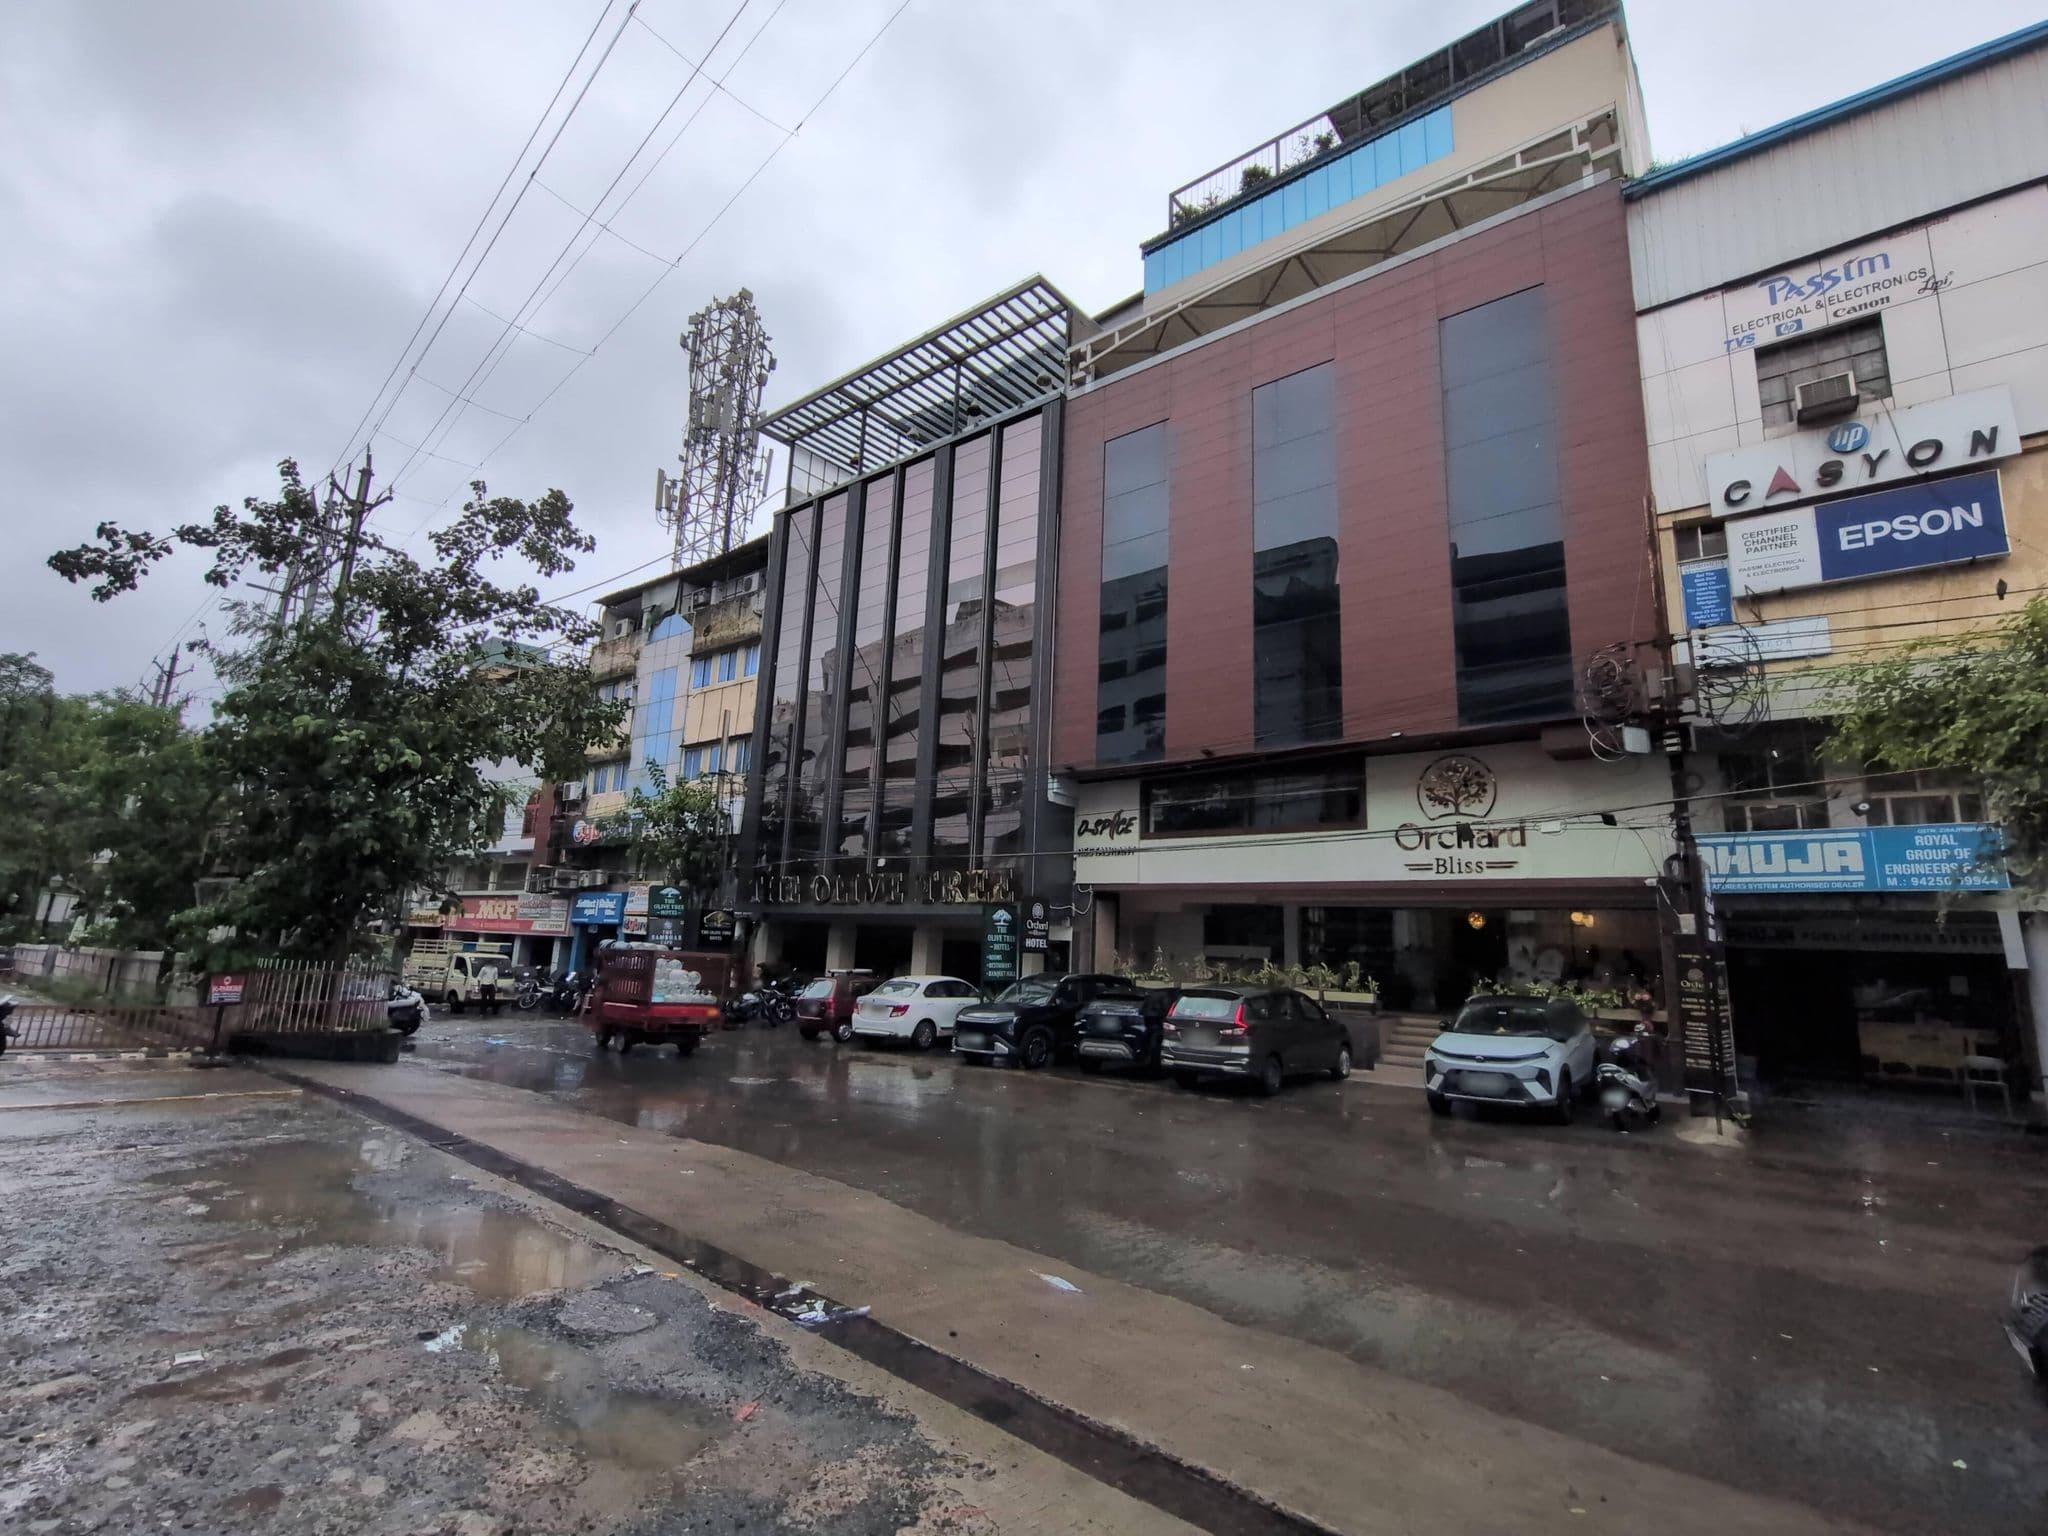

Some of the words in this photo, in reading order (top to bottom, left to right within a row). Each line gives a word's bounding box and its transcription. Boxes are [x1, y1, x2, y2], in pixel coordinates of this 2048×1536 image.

[1732, 305, 1811, 335] ELECTRICAL
[1815, 299, 1824, 309] &
[1827, 267, 1927, 306] ELECTRONICS
[1832, 296, 1891, 318] Canon
[1724, 333, 1755, 352] TVS
[1741, 524, 1799, 540] CERTIFIED
[1838, 502, 1984, 551] EPSON
[1744, 533, 1797, 547] CHANNEL
[1746, 540, 1798, 554] PARTNER
[1764, 558, 1805, 569] ELECTRICAL
[1914, 834, 1959, 846] ROYAL
[1905, 848, 1951, 861] GROUP
[1434, 857, 1484, 874] Bliss
[1884, 863, 1959, 875] ENGINEERS
[811, 873, 904, 903] OLIVE
[1831, 881, 1864, 889] DEALER
[476, 900, 517, 920] MRF
[1025, 937, 1049, 948] HOTEL
